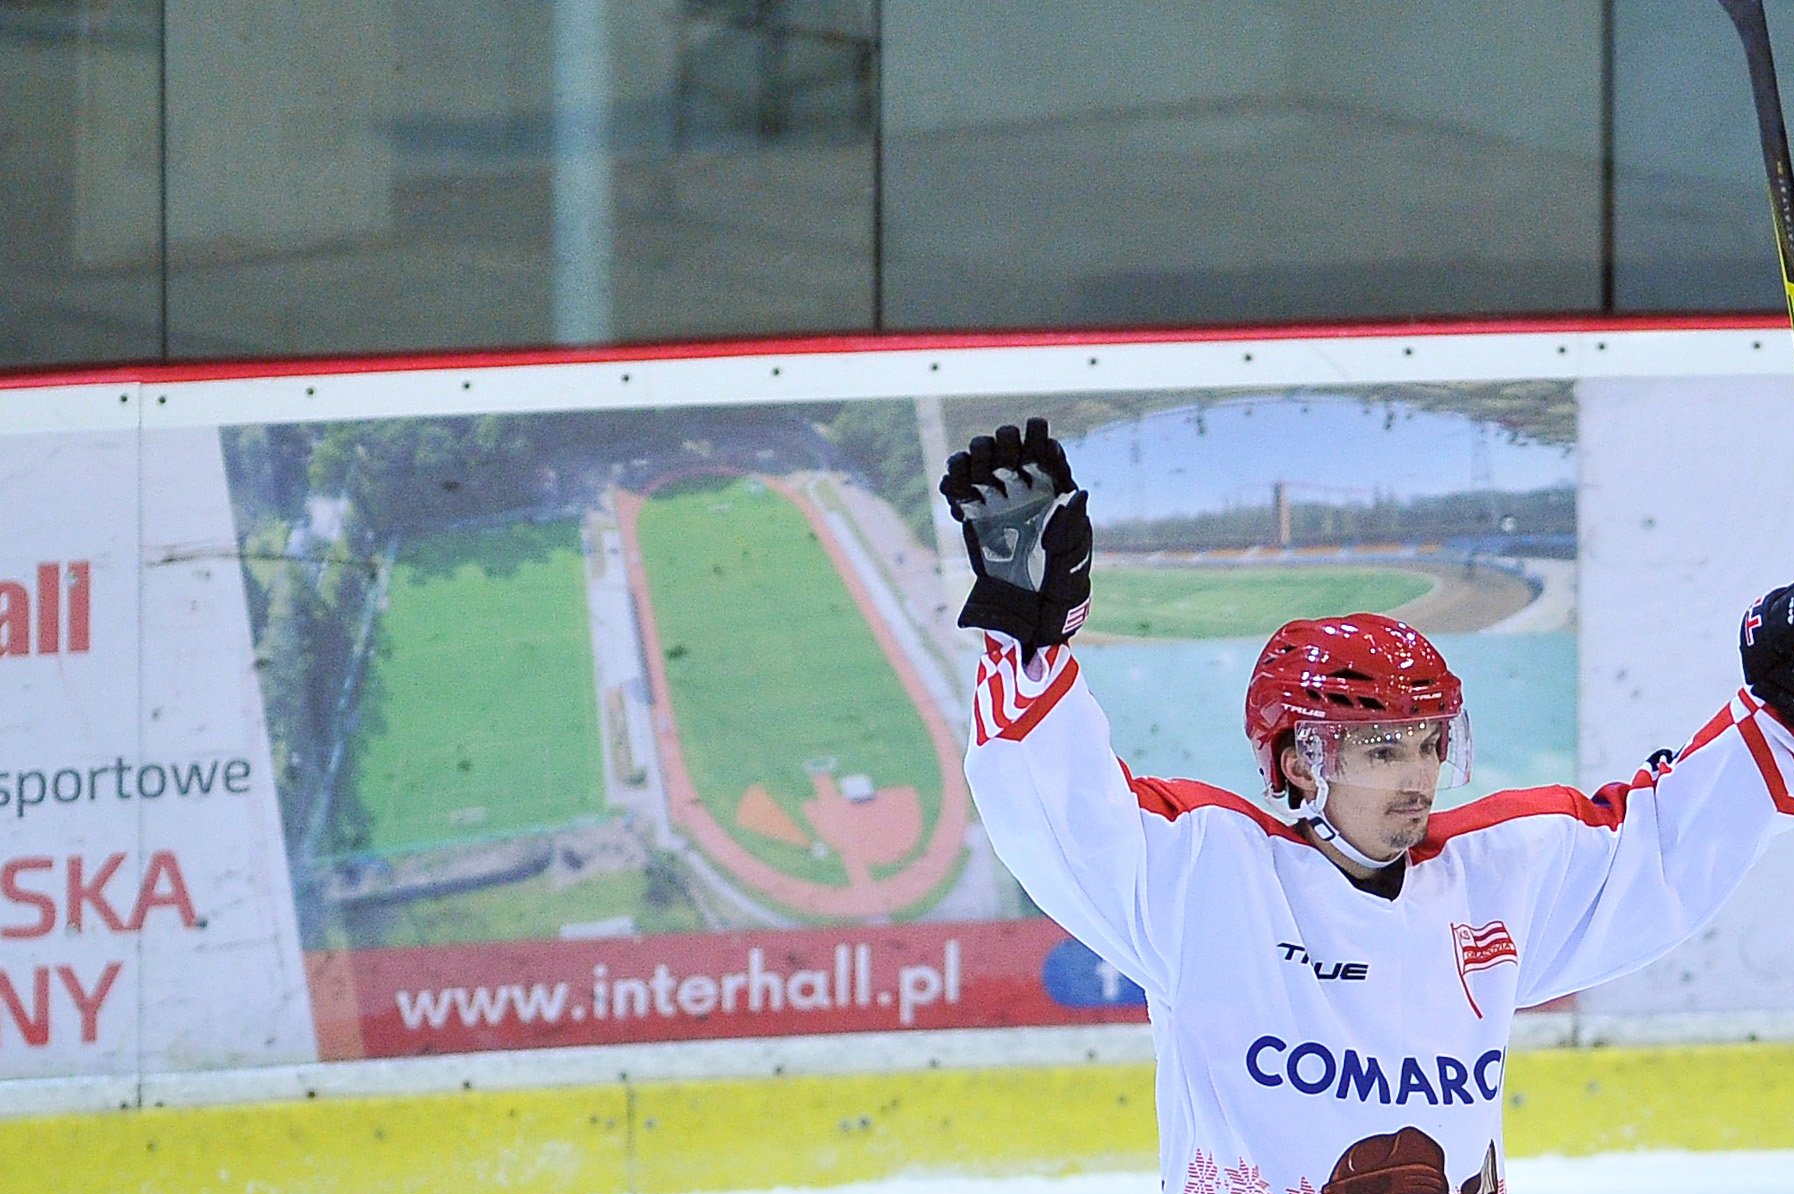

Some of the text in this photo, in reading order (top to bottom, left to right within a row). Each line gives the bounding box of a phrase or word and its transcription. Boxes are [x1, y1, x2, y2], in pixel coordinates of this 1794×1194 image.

[1280, 702, 1327, 719] TRUE
[1411, 692, 1443, 702] TRUE
[398, 938, 963, 1030] www.interhall.pl
[1245, 1034, 1506, 1105] COMARC
